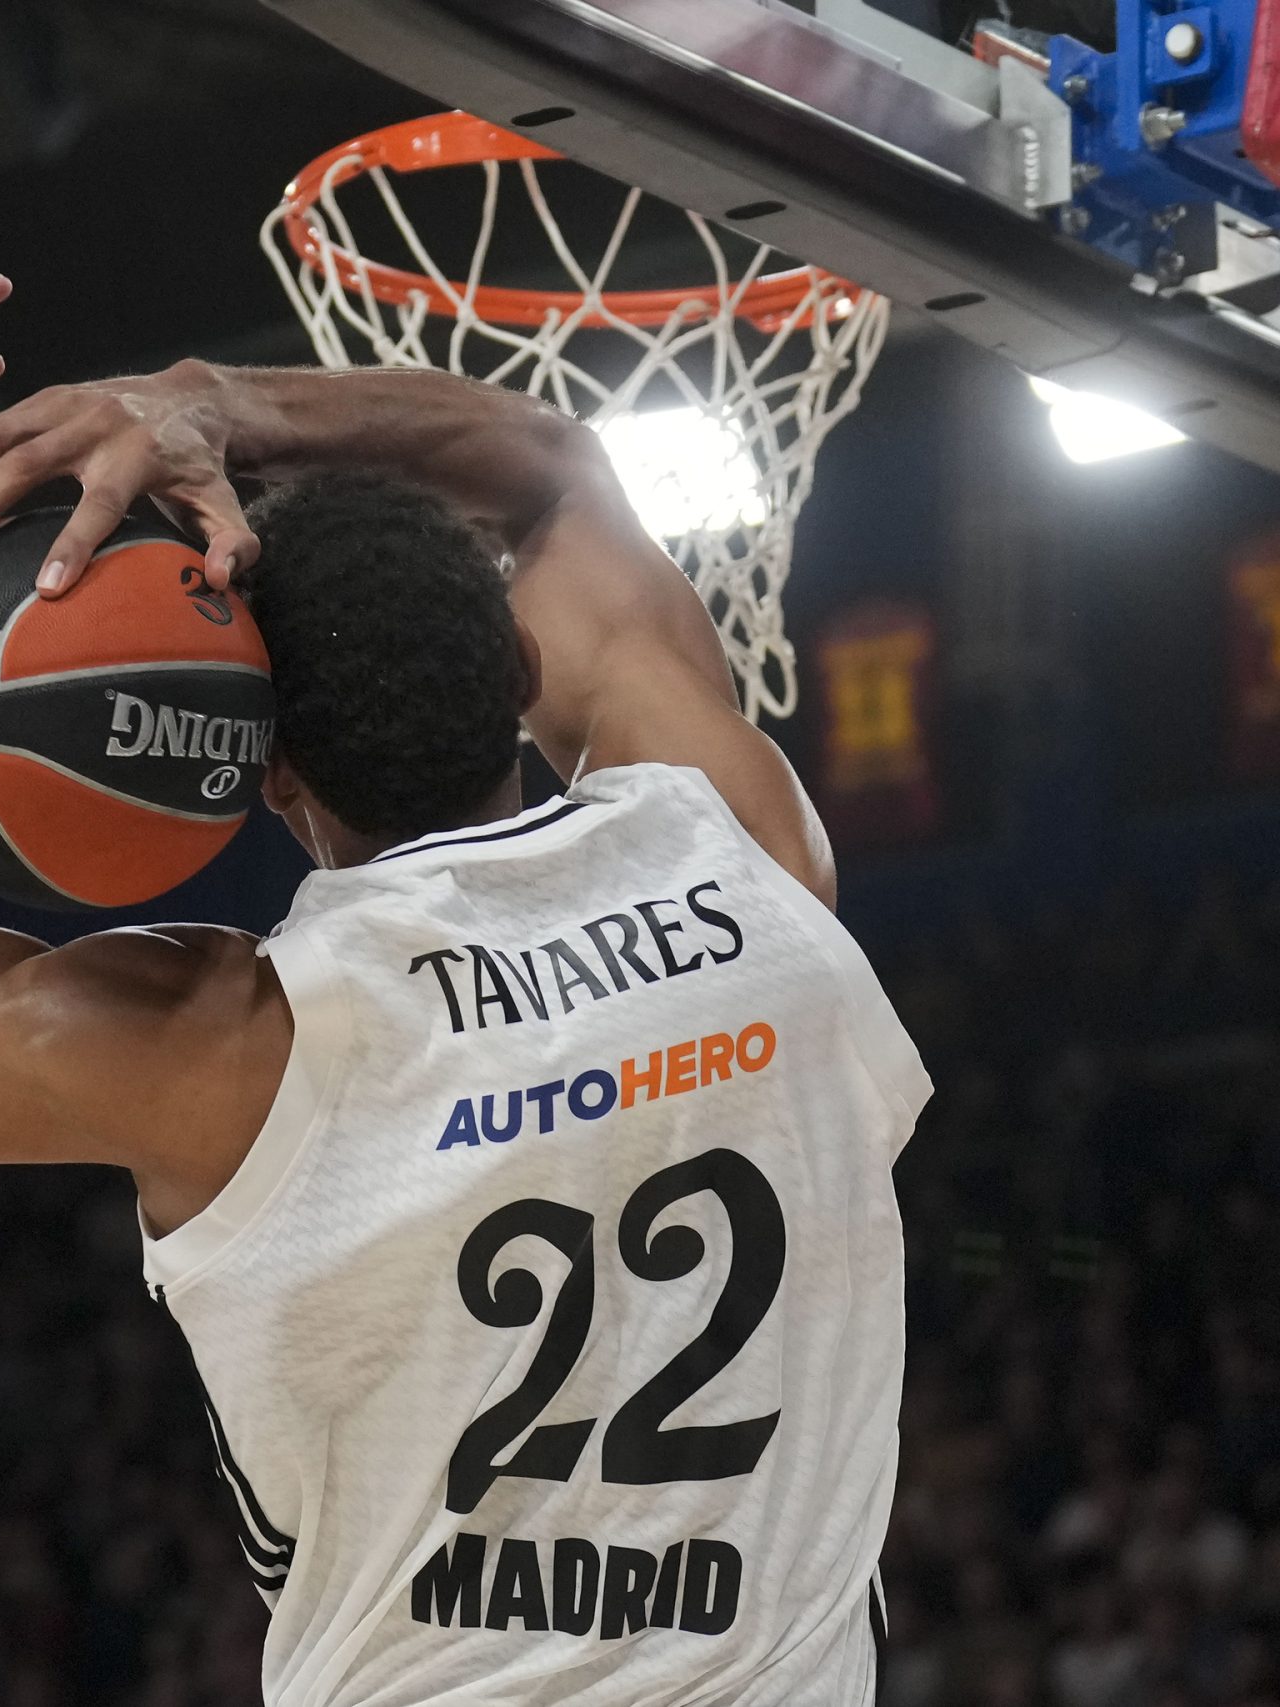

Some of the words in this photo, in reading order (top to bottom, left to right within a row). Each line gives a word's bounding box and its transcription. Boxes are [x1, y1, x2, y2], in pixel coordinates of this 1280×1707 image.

[105, 691, 275, 766] PALDING
[408, 880, 744, 1034] TAVARES
[437, 1022, 777, 1150] AUTOHERO
[445, 1147, 787, 1515] 22
[410, 1532, 743, 1642] MADRID
